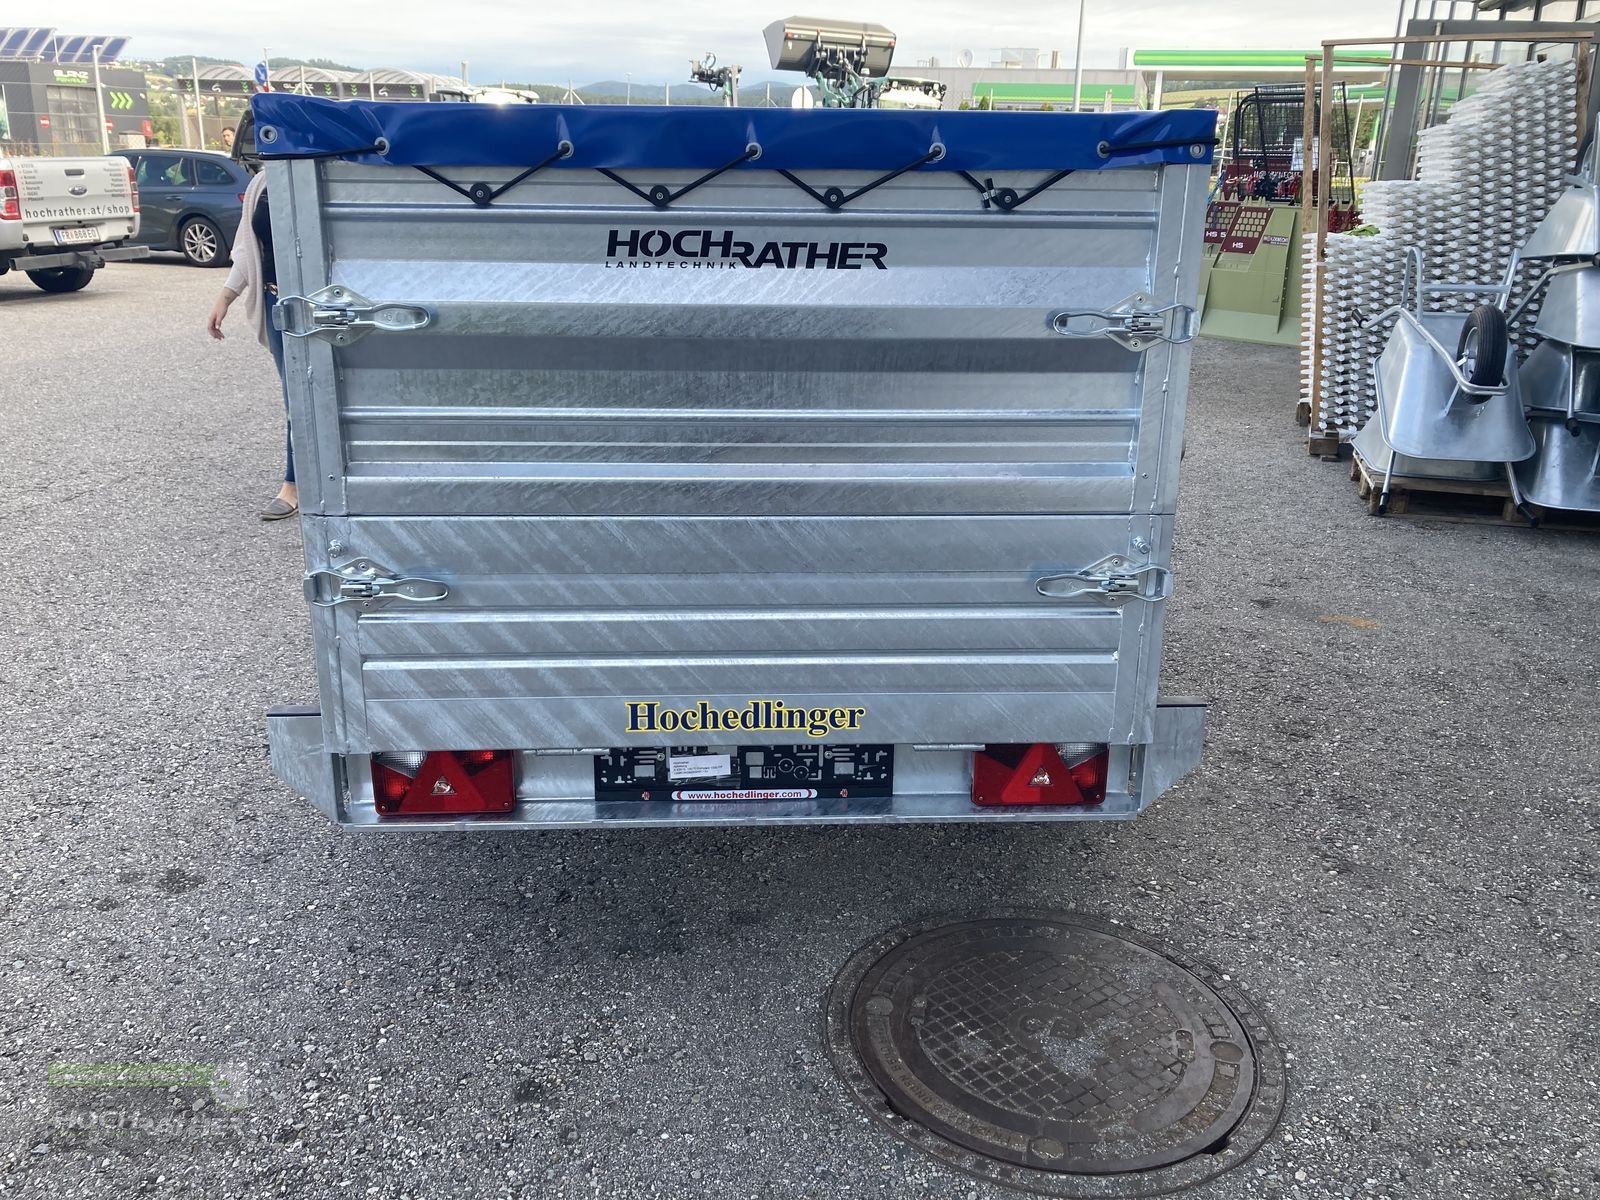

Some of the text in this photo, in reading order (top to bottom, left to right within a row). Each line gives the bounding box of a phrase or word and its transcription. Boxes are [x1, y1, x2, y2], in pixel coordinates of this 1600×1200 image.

[25, 205, 130, 219] hochrather.at/shop
[606, 229, 888, 270] HOCHRATHER
[604, 261, 737, 269] LANDTECHNIK
[625, 700, 865, 737] Hochedlinger
[687, 789, 803, 801] www.hochedlinger.com
